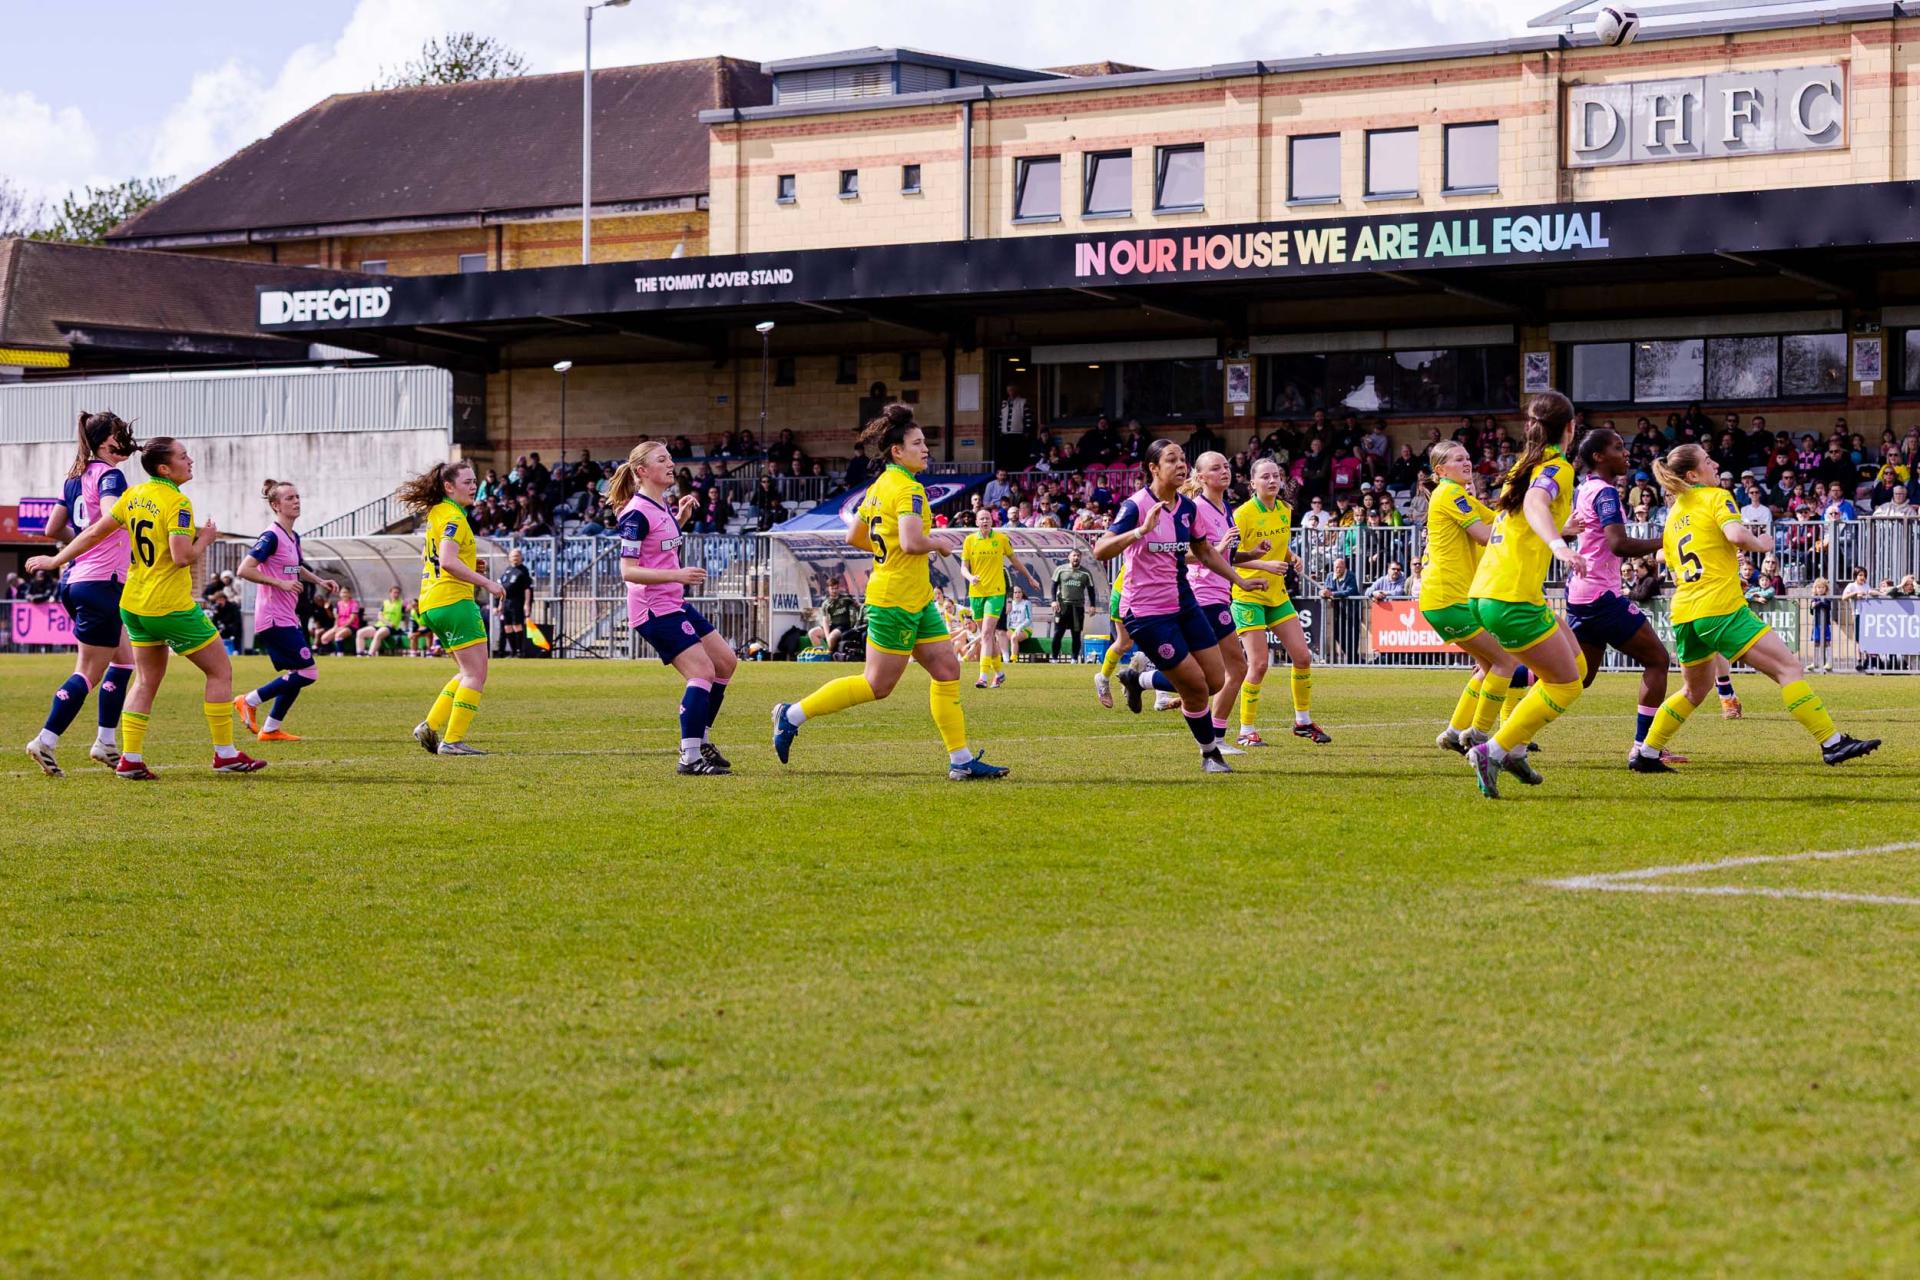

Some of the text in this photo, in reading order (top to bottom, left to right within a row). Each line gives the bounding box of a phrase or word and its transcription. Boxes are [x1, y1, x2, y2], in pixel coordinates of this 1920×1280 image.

[1572, 79, 1842, 152] DHFC
[1075, 211, 1610, 277] IN OUR HOUSE WE ARE ALL EQUAL
[260, 286, 391, 325] DEFECTED
[635, 268, 794, 293] THE TOMMY JOVER STAND
[129, 517, 156, 569] 16
[1677, 532, 1703, 583] 5
